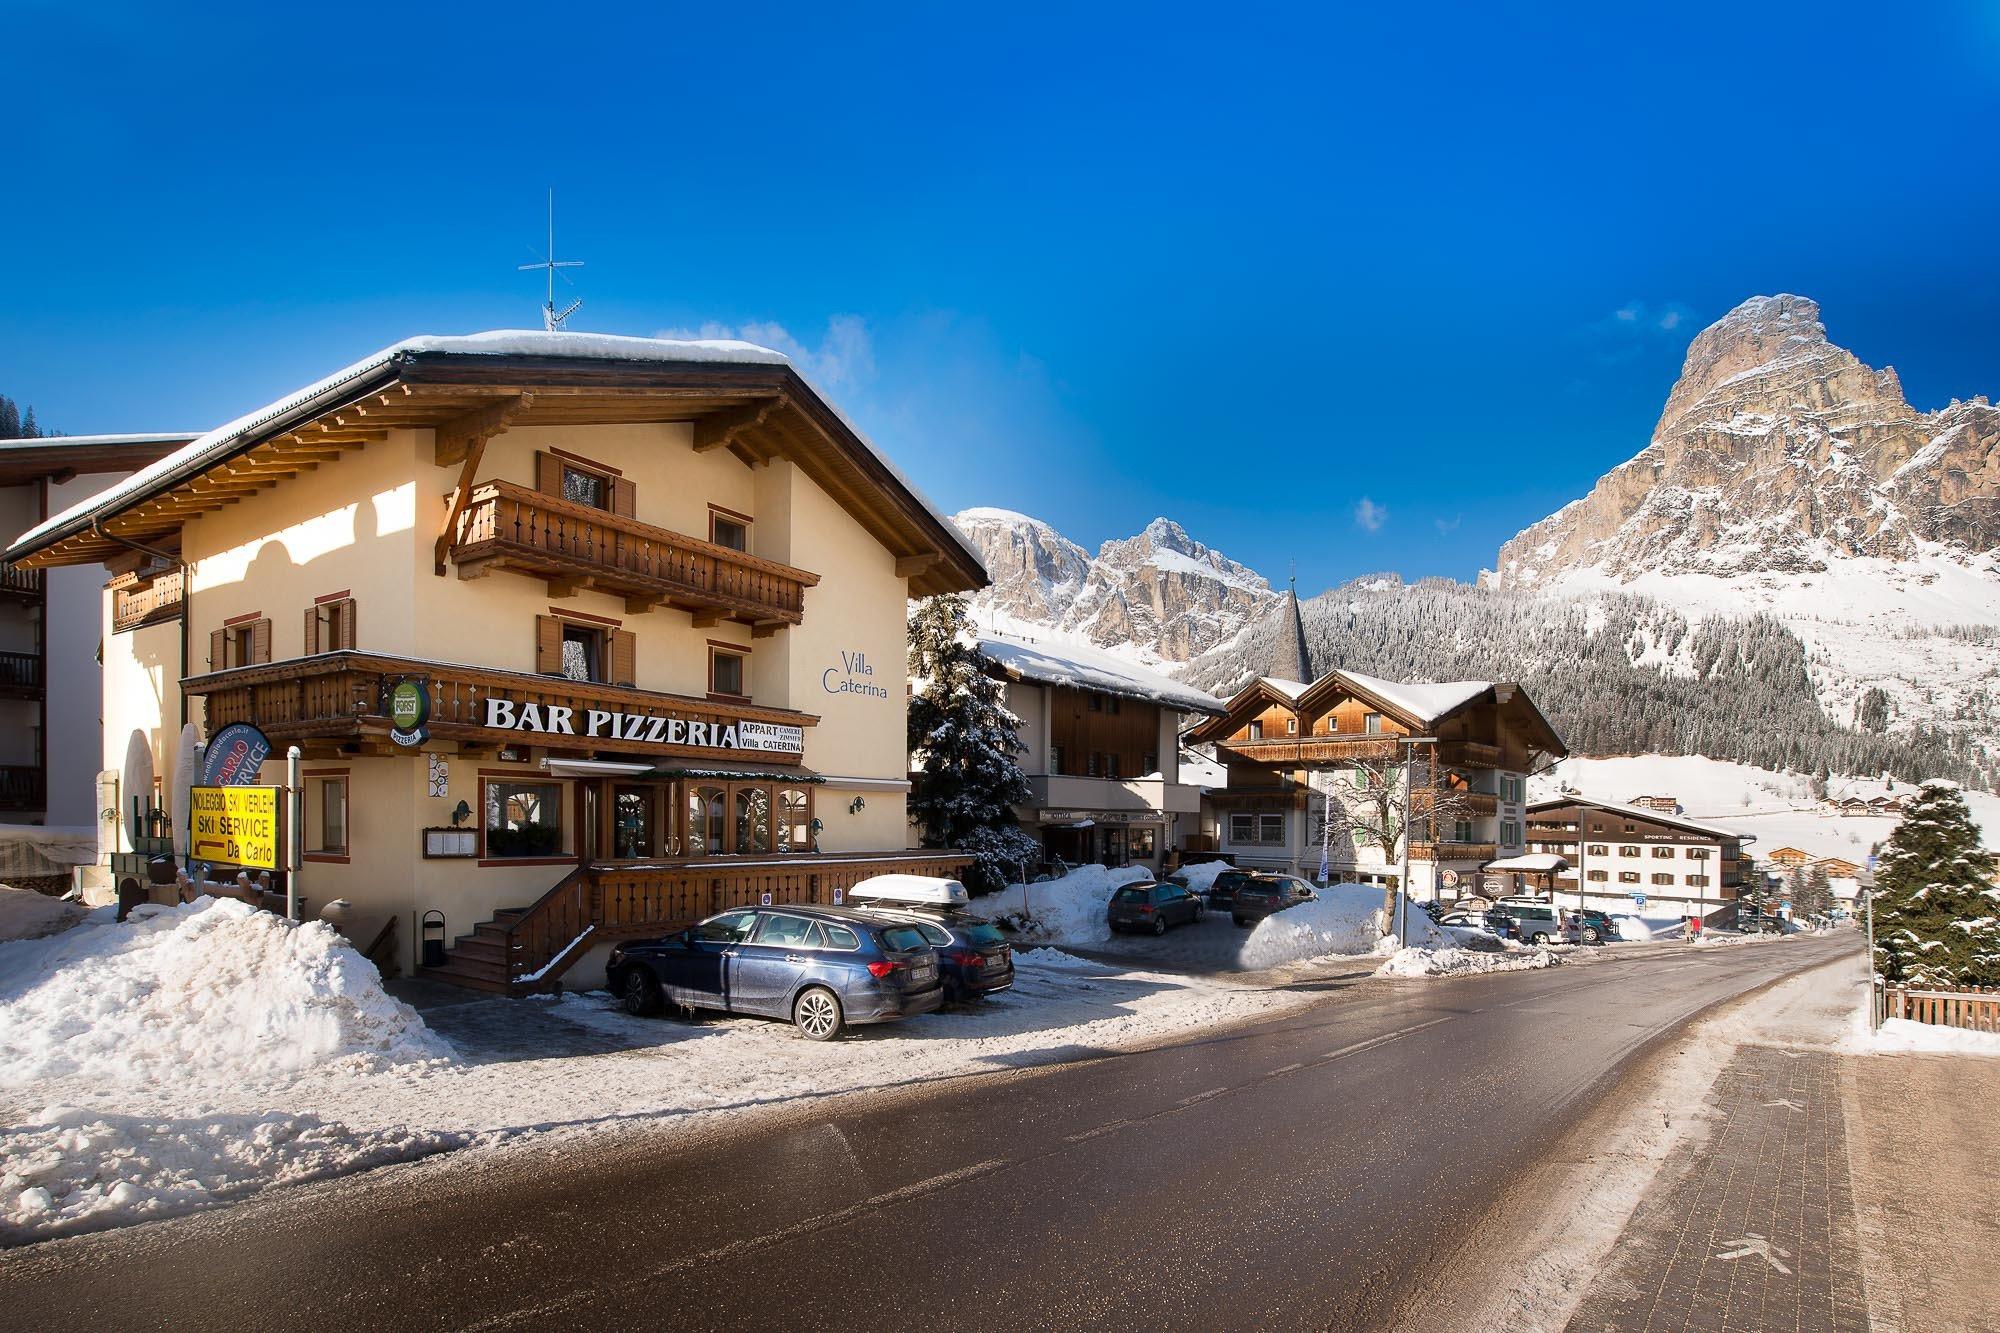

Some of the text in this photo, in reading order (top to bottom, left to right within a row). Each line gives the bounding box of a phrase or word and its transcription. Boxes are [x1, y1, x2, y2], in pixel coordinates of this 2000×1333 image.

[841, 650, 873, 676] Villa
[822, 668, 888, 699] Caterina
[396, 699, 416, 712] FORST
[484, 698, 740, 750] BAR PIZZERIA
[742, 723, 778, 736] APPART
[779, 727, 801, 736] CAMERE
[393, 732, 417, 745] PIZZERIA
[741, 738, 801, 752] Villa CATERINA
[779, 734, 801, 742] ZIMMER
[214, 739, 249, 785] CARLO
[193, 792, 275, 815] NOLEGGIO SKI VERLEIH
[198, 815, 269, 838] SKI SERVICE
[227, 839, 272, 862] Da Carlo
